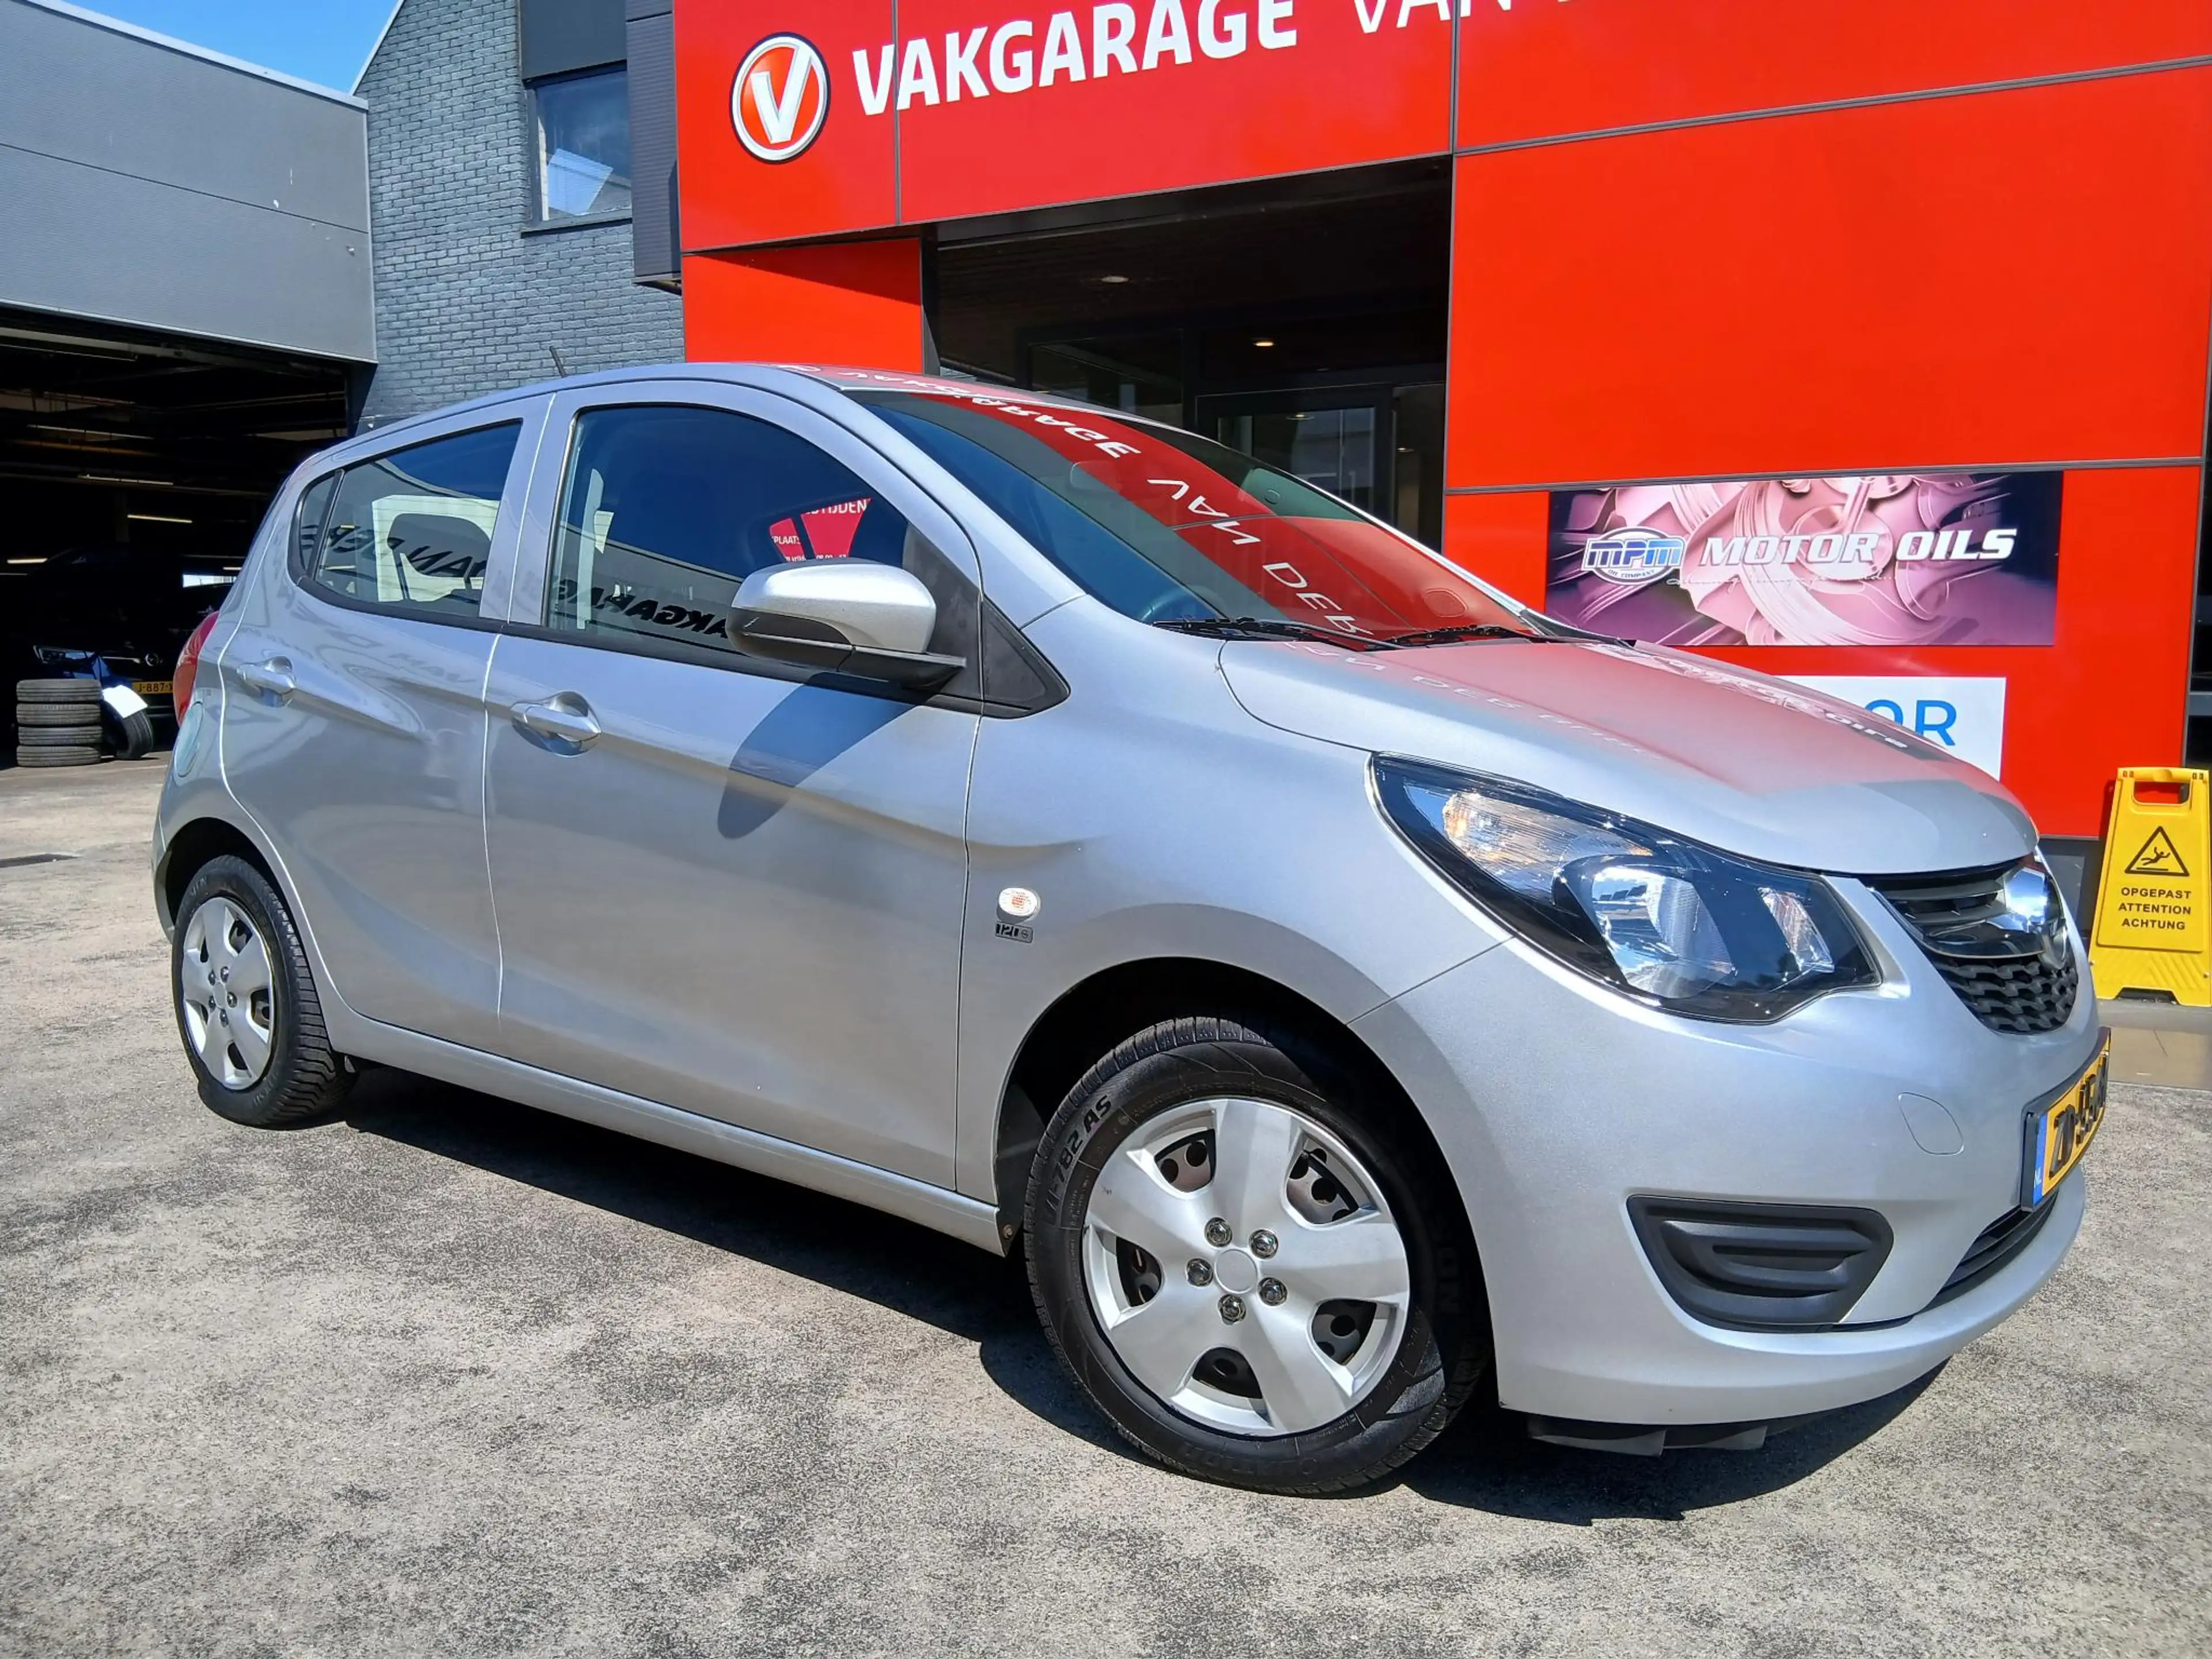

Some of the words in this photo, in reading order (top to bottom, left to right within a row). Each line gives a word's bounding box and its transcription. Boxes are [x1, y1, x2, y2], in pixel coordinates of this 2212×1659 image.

[853, 0, 1298, 116] VAKGARAGE
[1700, 532, 1881, 566] MOTOR
[1895, 528, 2017, 561] OILS
[2121, 887, 2192, 899] OPGEPAST
[2118, 902, 2191, 915] ATTENTION
[2122, 918, 2186, 930] ACHTUNG
[1083, 1094, 1112, 1134] AS
